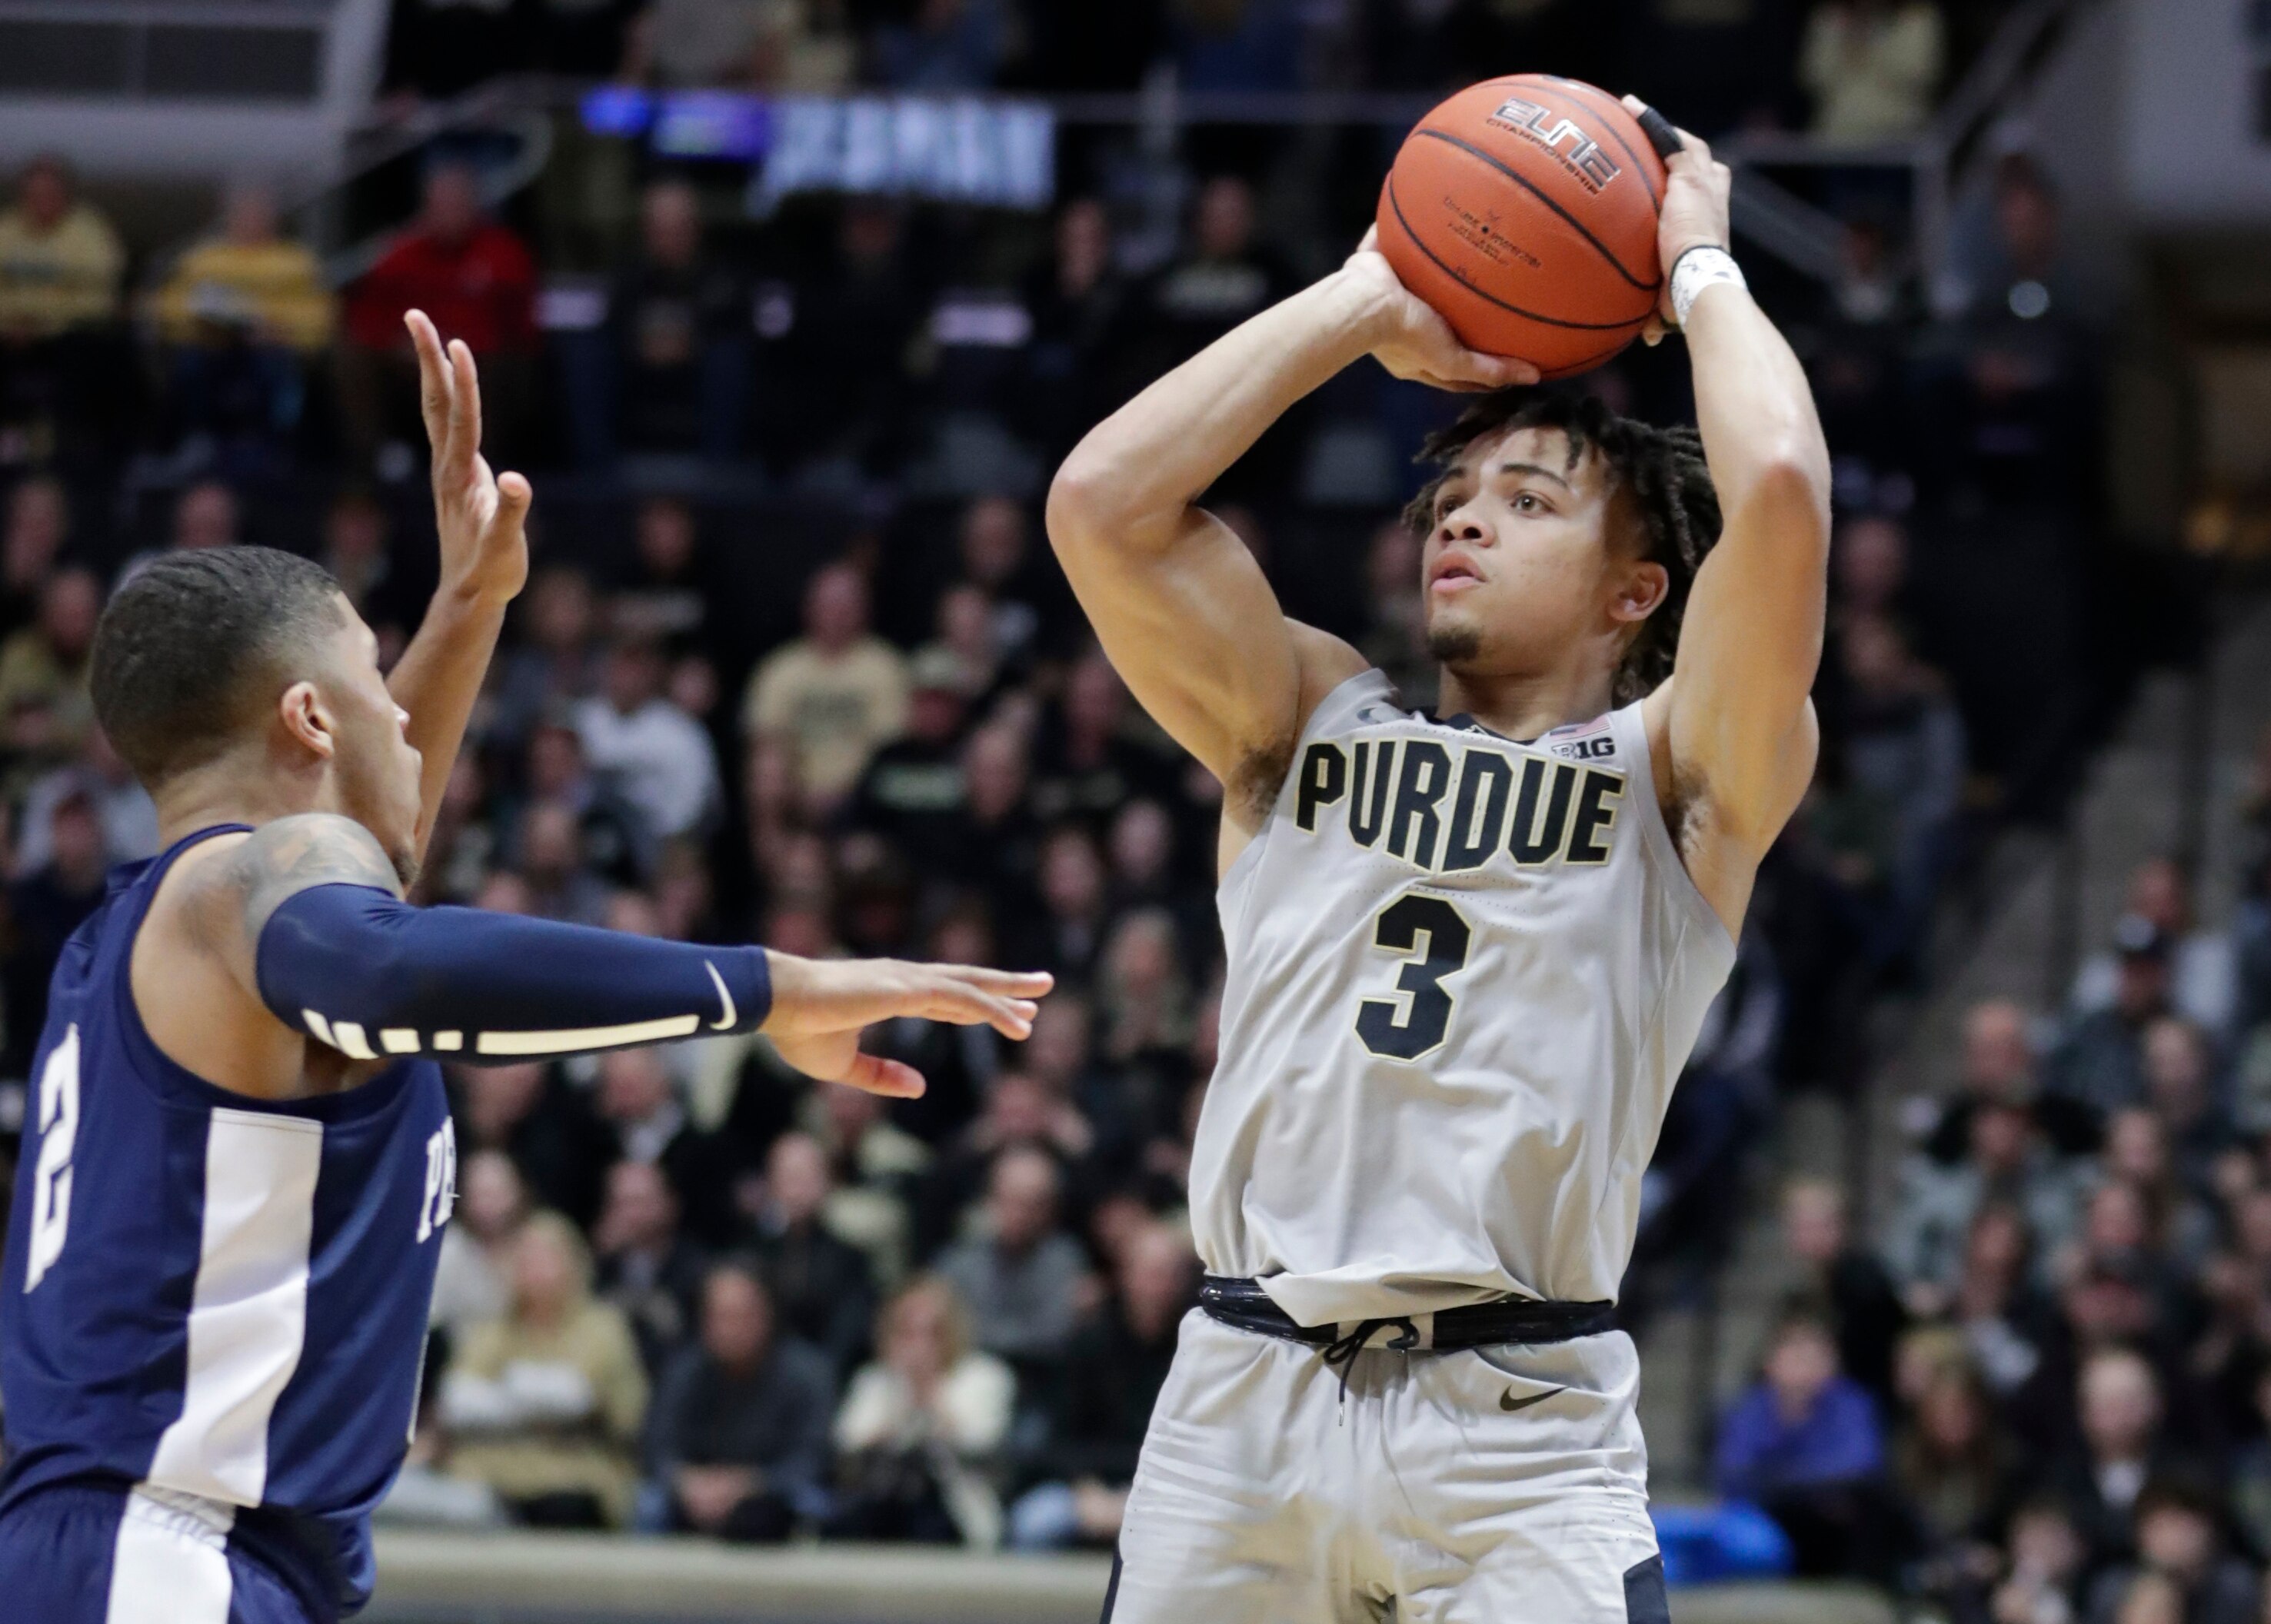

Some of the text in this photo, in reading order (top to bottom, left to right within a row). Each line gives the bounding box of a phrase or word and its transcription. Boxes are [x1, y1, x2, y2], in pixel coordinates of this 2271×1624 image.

[1486, 118, 1599, 195] CHAMPIONSHIP
[1493, 98, 1622, 190] ELITE
[1294, 736, 1627, 875] PURDUE
[1352, 890, 1475, 1063] 3
[22, 1022, 80, 1294] 2
